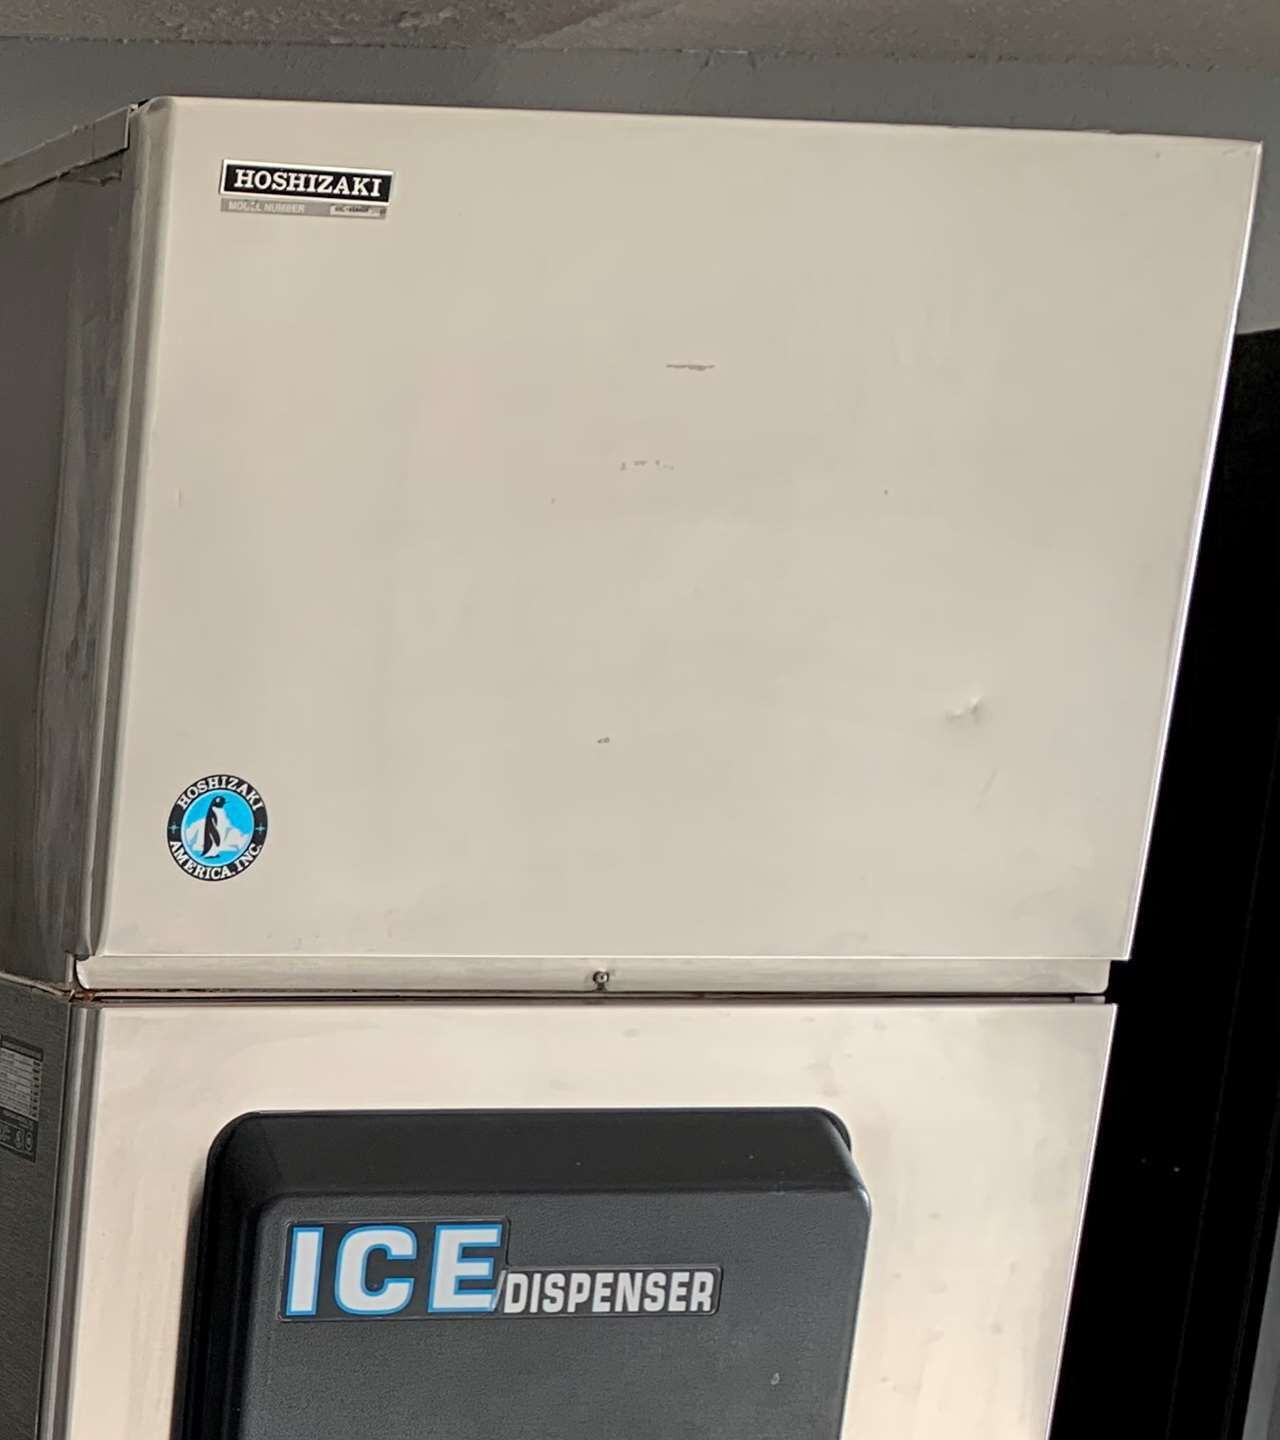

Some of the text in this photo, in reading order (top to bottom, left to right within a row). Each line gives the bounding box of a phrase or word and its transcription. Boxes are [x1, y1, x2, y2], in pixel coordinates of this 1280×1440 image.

[233, 168, 382, 197] HOSHIZAKI
[176, 775, 265, 811] HOSHIZAKI
[285, 1223, 715, 1316] ICE DISPENSER
